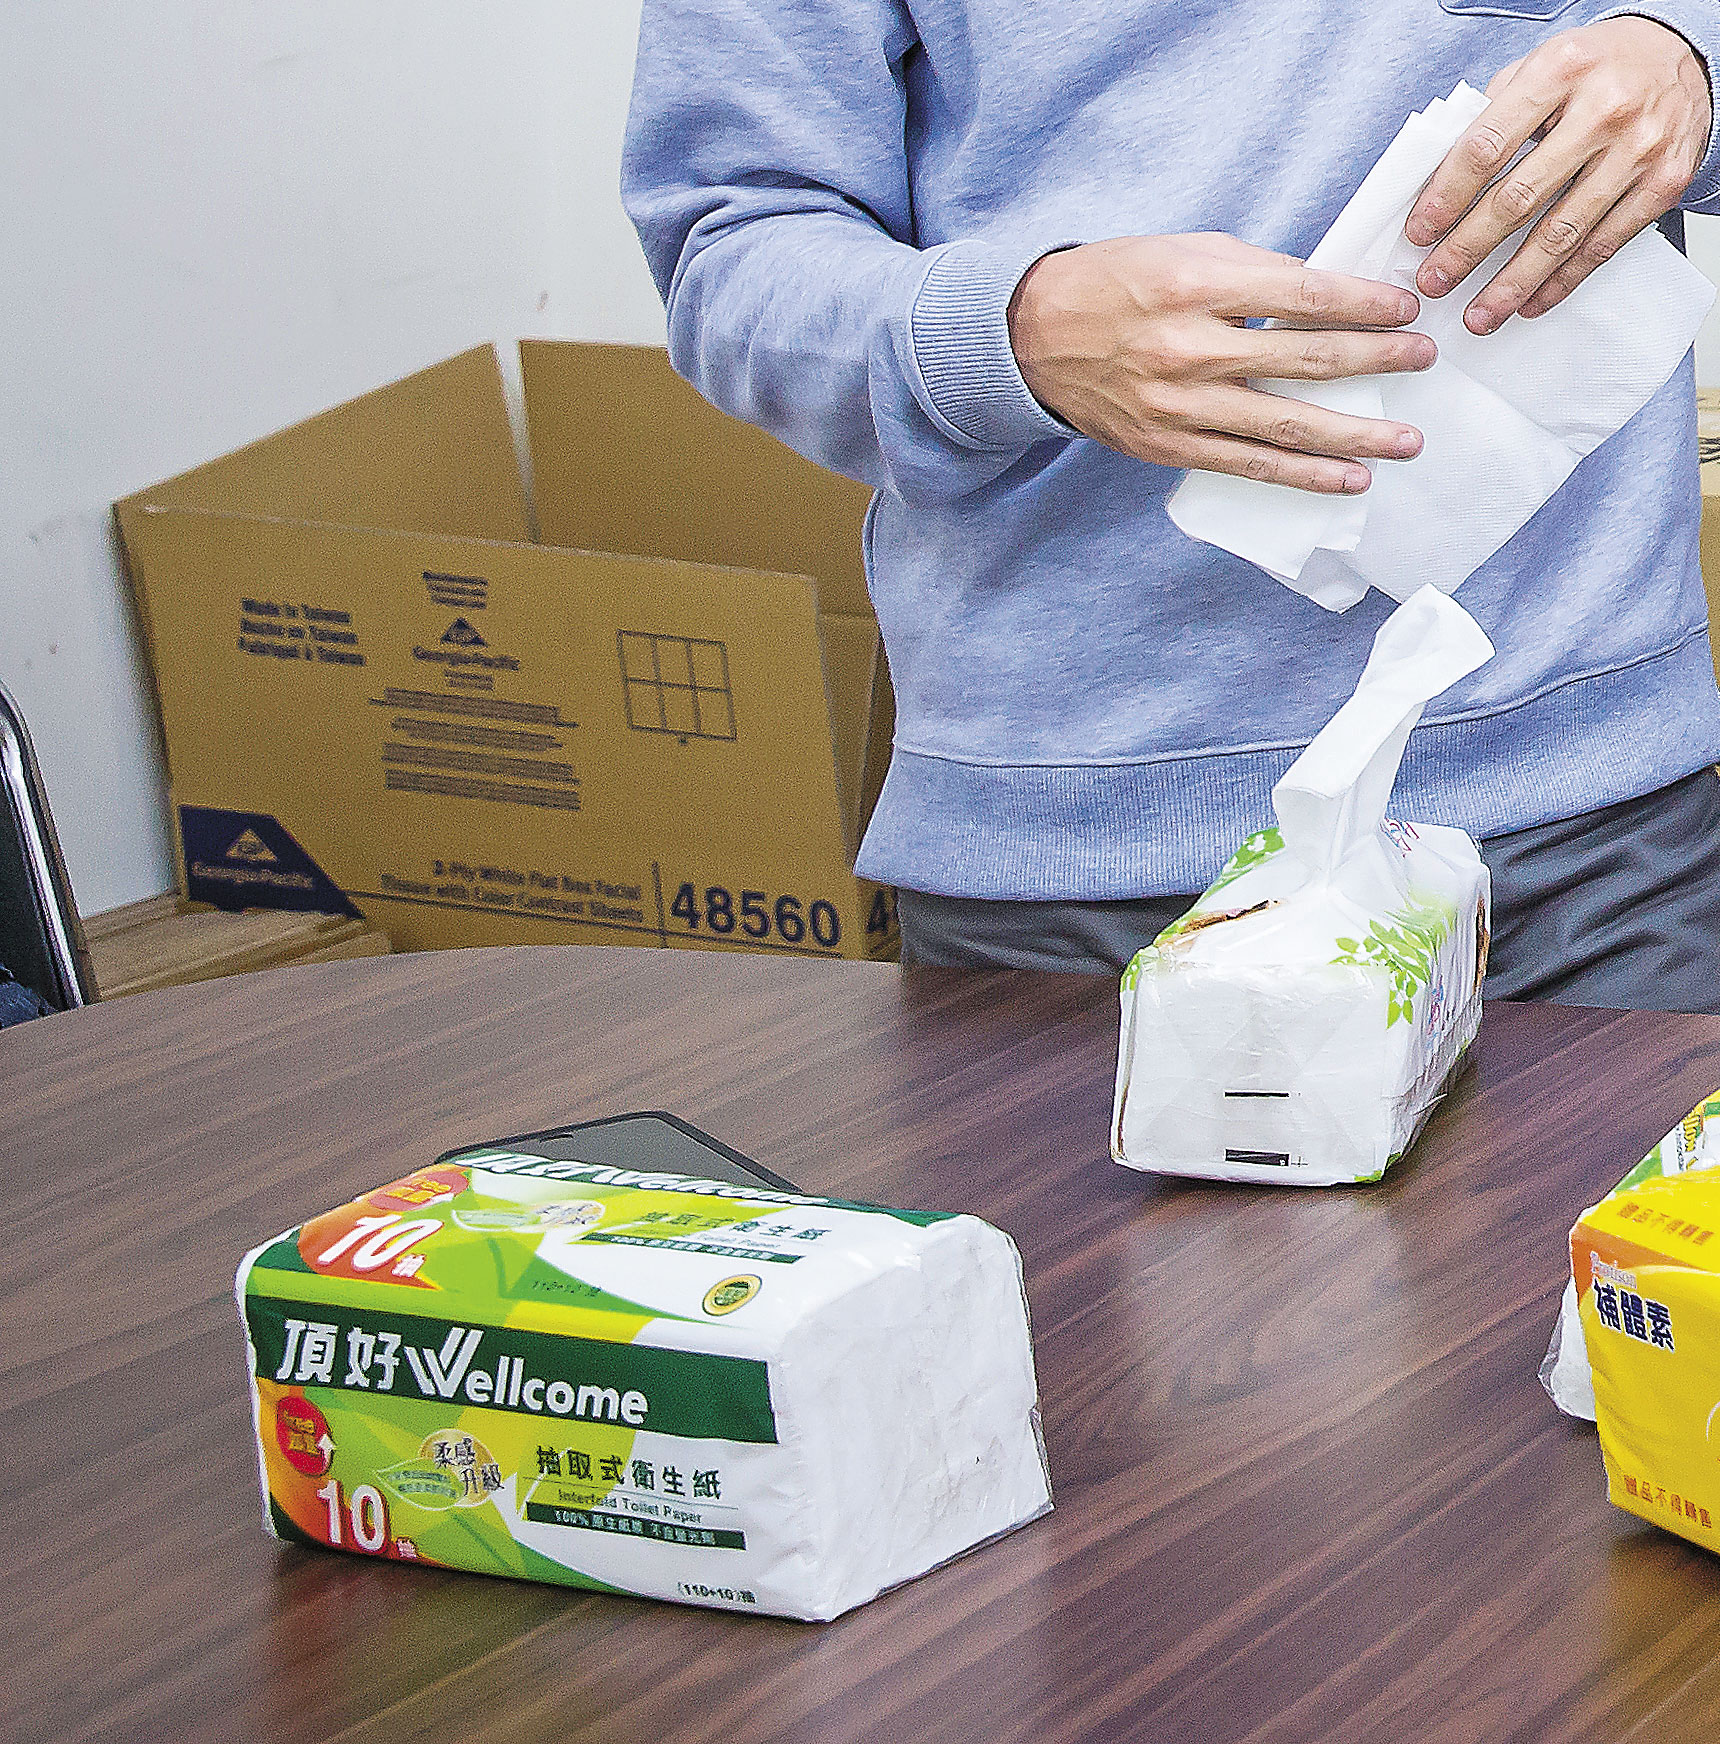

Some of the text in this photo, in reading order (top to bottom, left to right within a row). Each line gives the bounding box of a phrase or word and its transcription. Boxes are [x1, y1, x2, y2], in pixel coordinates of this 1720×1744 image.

[671, 881, 841, 948] 48560
[1593, 1281, 1676, 1353] 補體素
[276, 1318, 648, 1425] 頂好 Wellcome
[537, 1445, 721, 1500] 抽取式衛生紙
[664, 1505, 702, 1523] Paper
